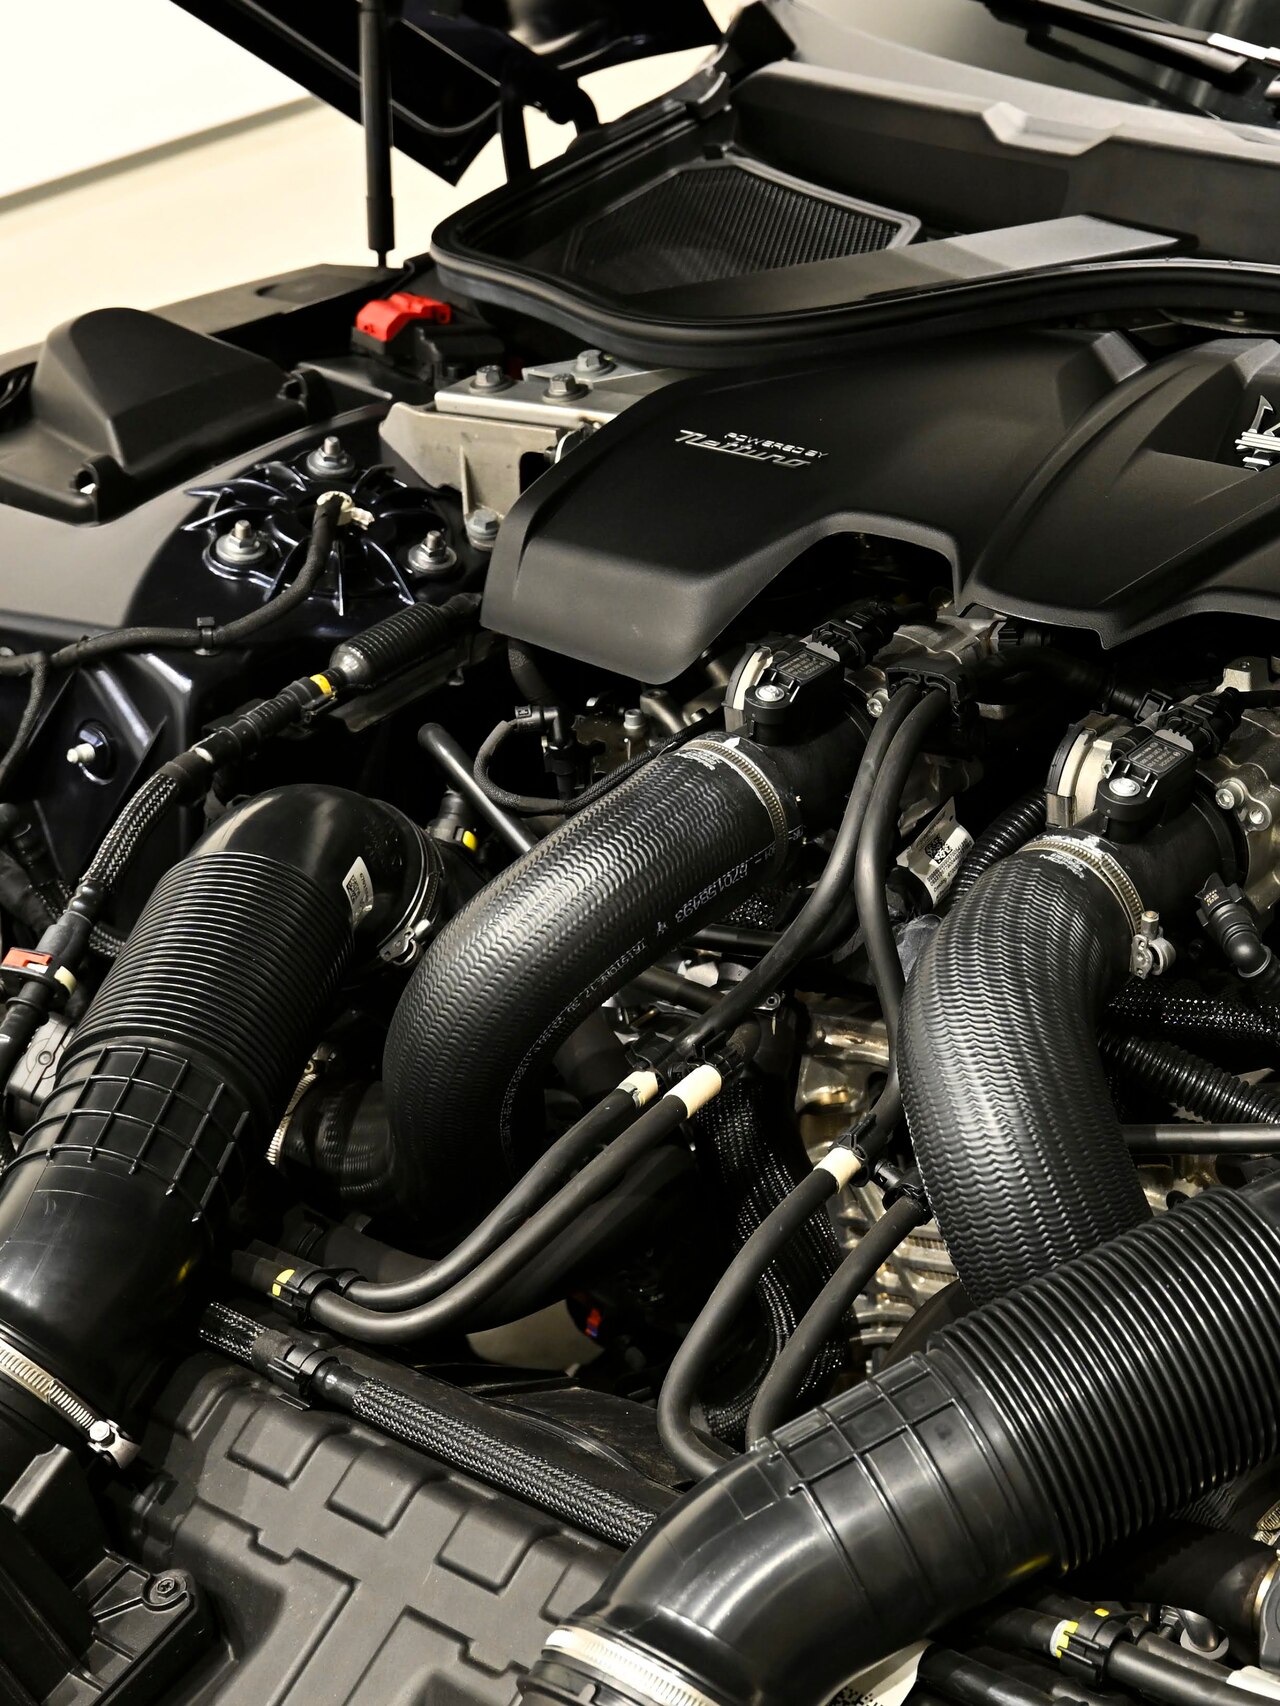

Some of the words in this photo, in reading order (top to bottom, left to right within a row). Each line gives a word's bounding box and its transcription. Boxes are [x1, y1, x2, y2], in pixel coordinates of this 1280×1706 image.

[674, 429, 812, 469] Nettuno
[724, 432, 805, 454] POWERED
[804, 449, 829, 459] BY
